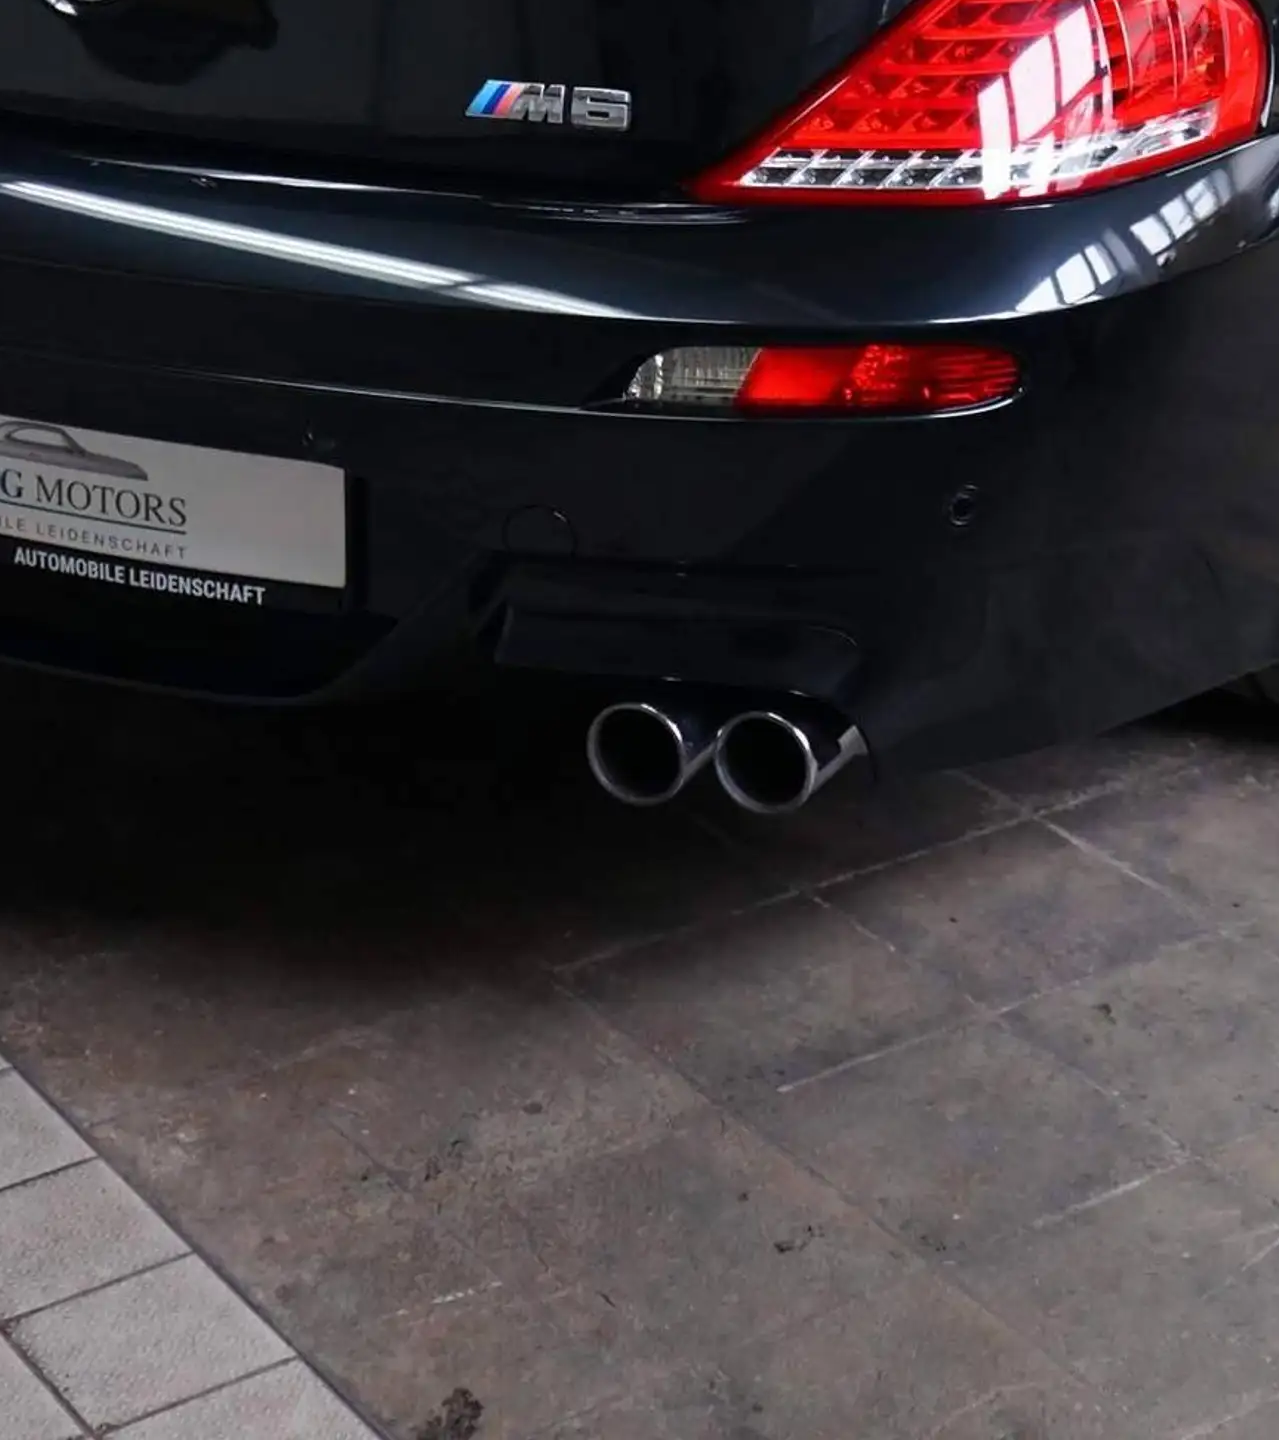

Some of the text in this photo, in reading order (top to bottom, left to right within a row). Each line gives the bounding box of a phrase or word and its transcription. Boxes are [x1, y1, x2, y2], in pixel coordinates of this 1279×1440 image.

[503, 80, 632, 131] M6
[36, 478, 187, 527] MOTORS
[36, 522, 187, 560] LEIDENSCHAFT
[14, 547, 125, 585] AUTOMOBILE
[129, 568, 266, 606] LEIDENSCHAFT
